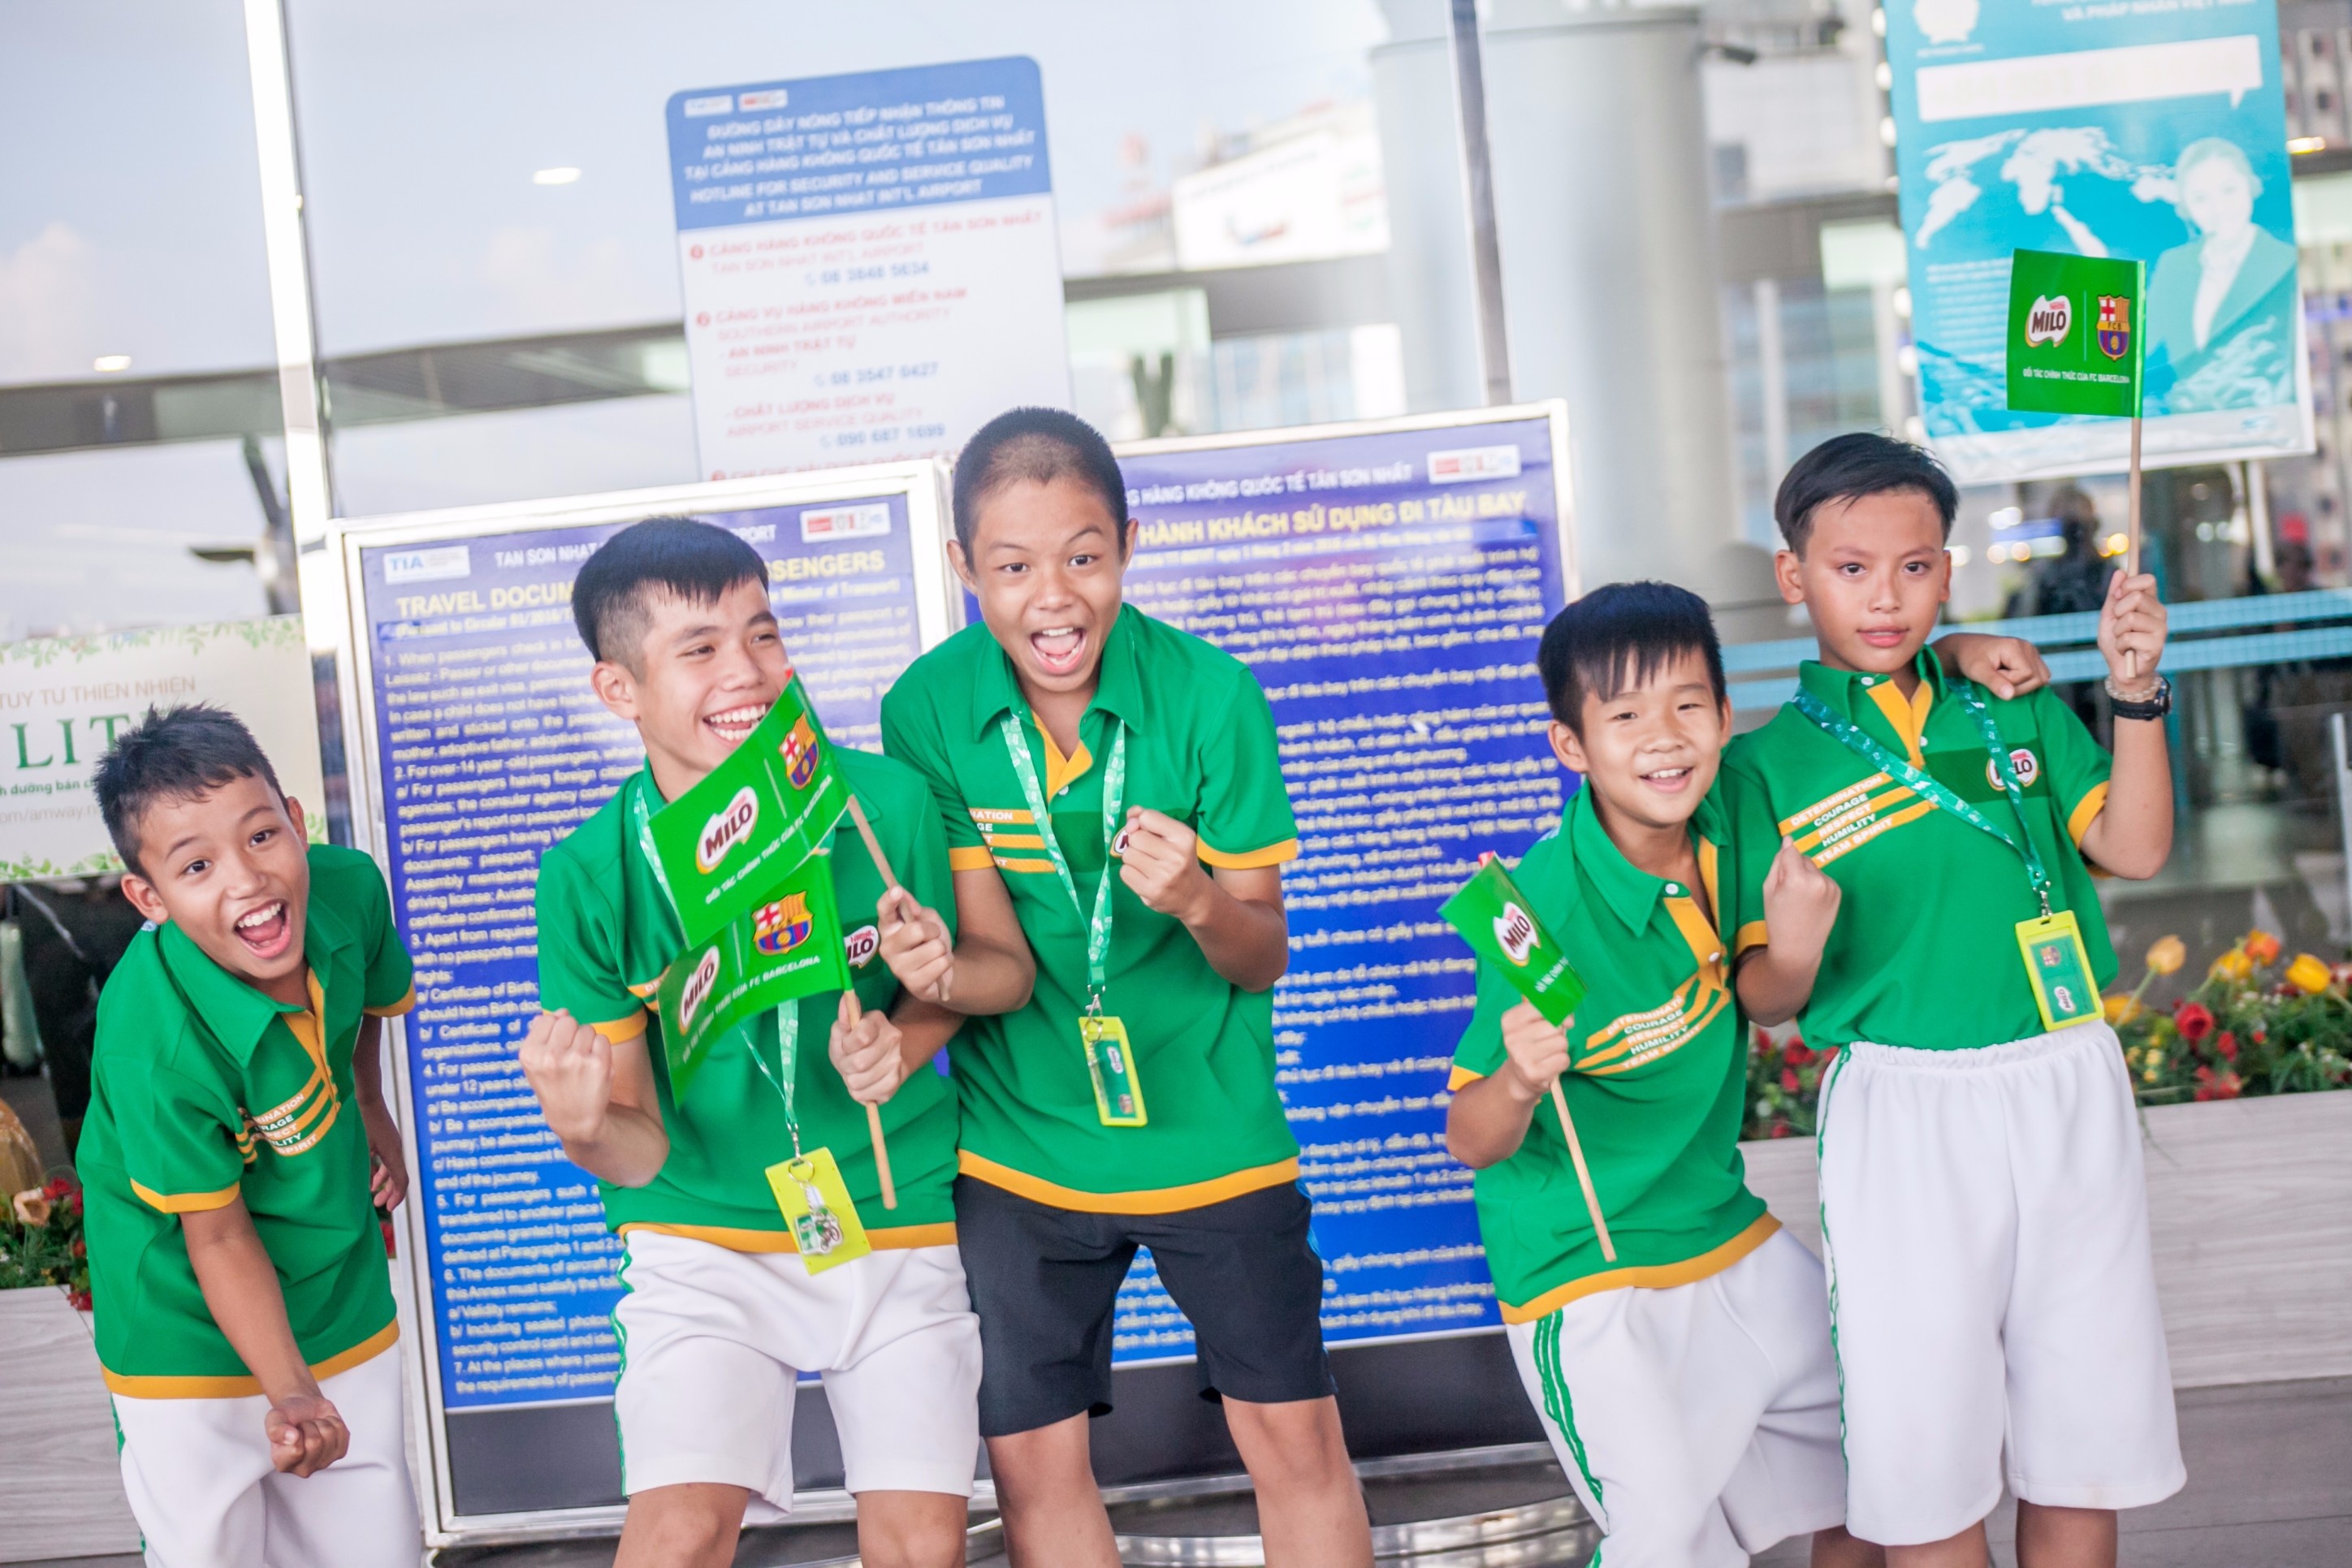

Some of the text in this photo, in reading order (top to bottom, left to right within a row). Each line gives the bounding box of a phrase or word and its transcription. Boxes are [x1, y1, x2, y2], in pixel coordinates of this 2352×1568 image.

[689, 153, 1035, 203] HOTLINE FOR SECURITY AND SERVICE QUALITY
[767, 197, 799, 215] TAN
[833, 190, 876, 209] NHAT
[916, 177, 984, 200] AIRPORT
[2031, 310, 2067, 334] MILO
[1138, 489, 1528, 547] HÀNH KHÁCH SỬ DỤNG ĐI TÀU BAY
[388, 555, 424, 571] TIA
[494, 549, 524, 568] TAN
[525, 546, 556, 566] SON
[765, 549, 885, 581] SENGERS
[396, 581, 573, 619] TRAVEL DOCUM
[411, 783, 434, 797] For
[435, 777, 508, 798] passengers
[508, 772, 551, 792] having
[553, 767, 597, 788] foreign
[456, 797, 477, 813] the
[532, 790, 577, 808] agency
[1790, 775, 1883, 827] DETERMINATION
[1814, 793, 1868, 827] COURAGE
[705, 803, 753, 860] MILO
[1818, 803, 1872, 837] RESPECT
[1822, 813, 1876, 847] HUMILITY
[416, 840, 437, 853] For
[438, 833, 508, 854] passengers
[509, 829, 551, 848] having
[1817, 818, 1892, 863] TEAM SPIRIT
[404, 874, 465, 895] Assembly
[847, 938, 874, 960] ILO
[1503, 915, 1530, 953] MILO
[763, 955, 821, 983] BARCELONA
[684, 962, 715, 1018] MILO
[1624, 1009, 1684, 1035] COURAGE
[1628, 1017, 1685, 1044] RESPECT
[1623, 1024, 1700, 1069] TEAM SPIRIT
[1631, 1025, 1688, 1055] HUMILITY
[260, 1114, 294, 1131] RAGE
[481, 1188, 551, 1207] passengers
